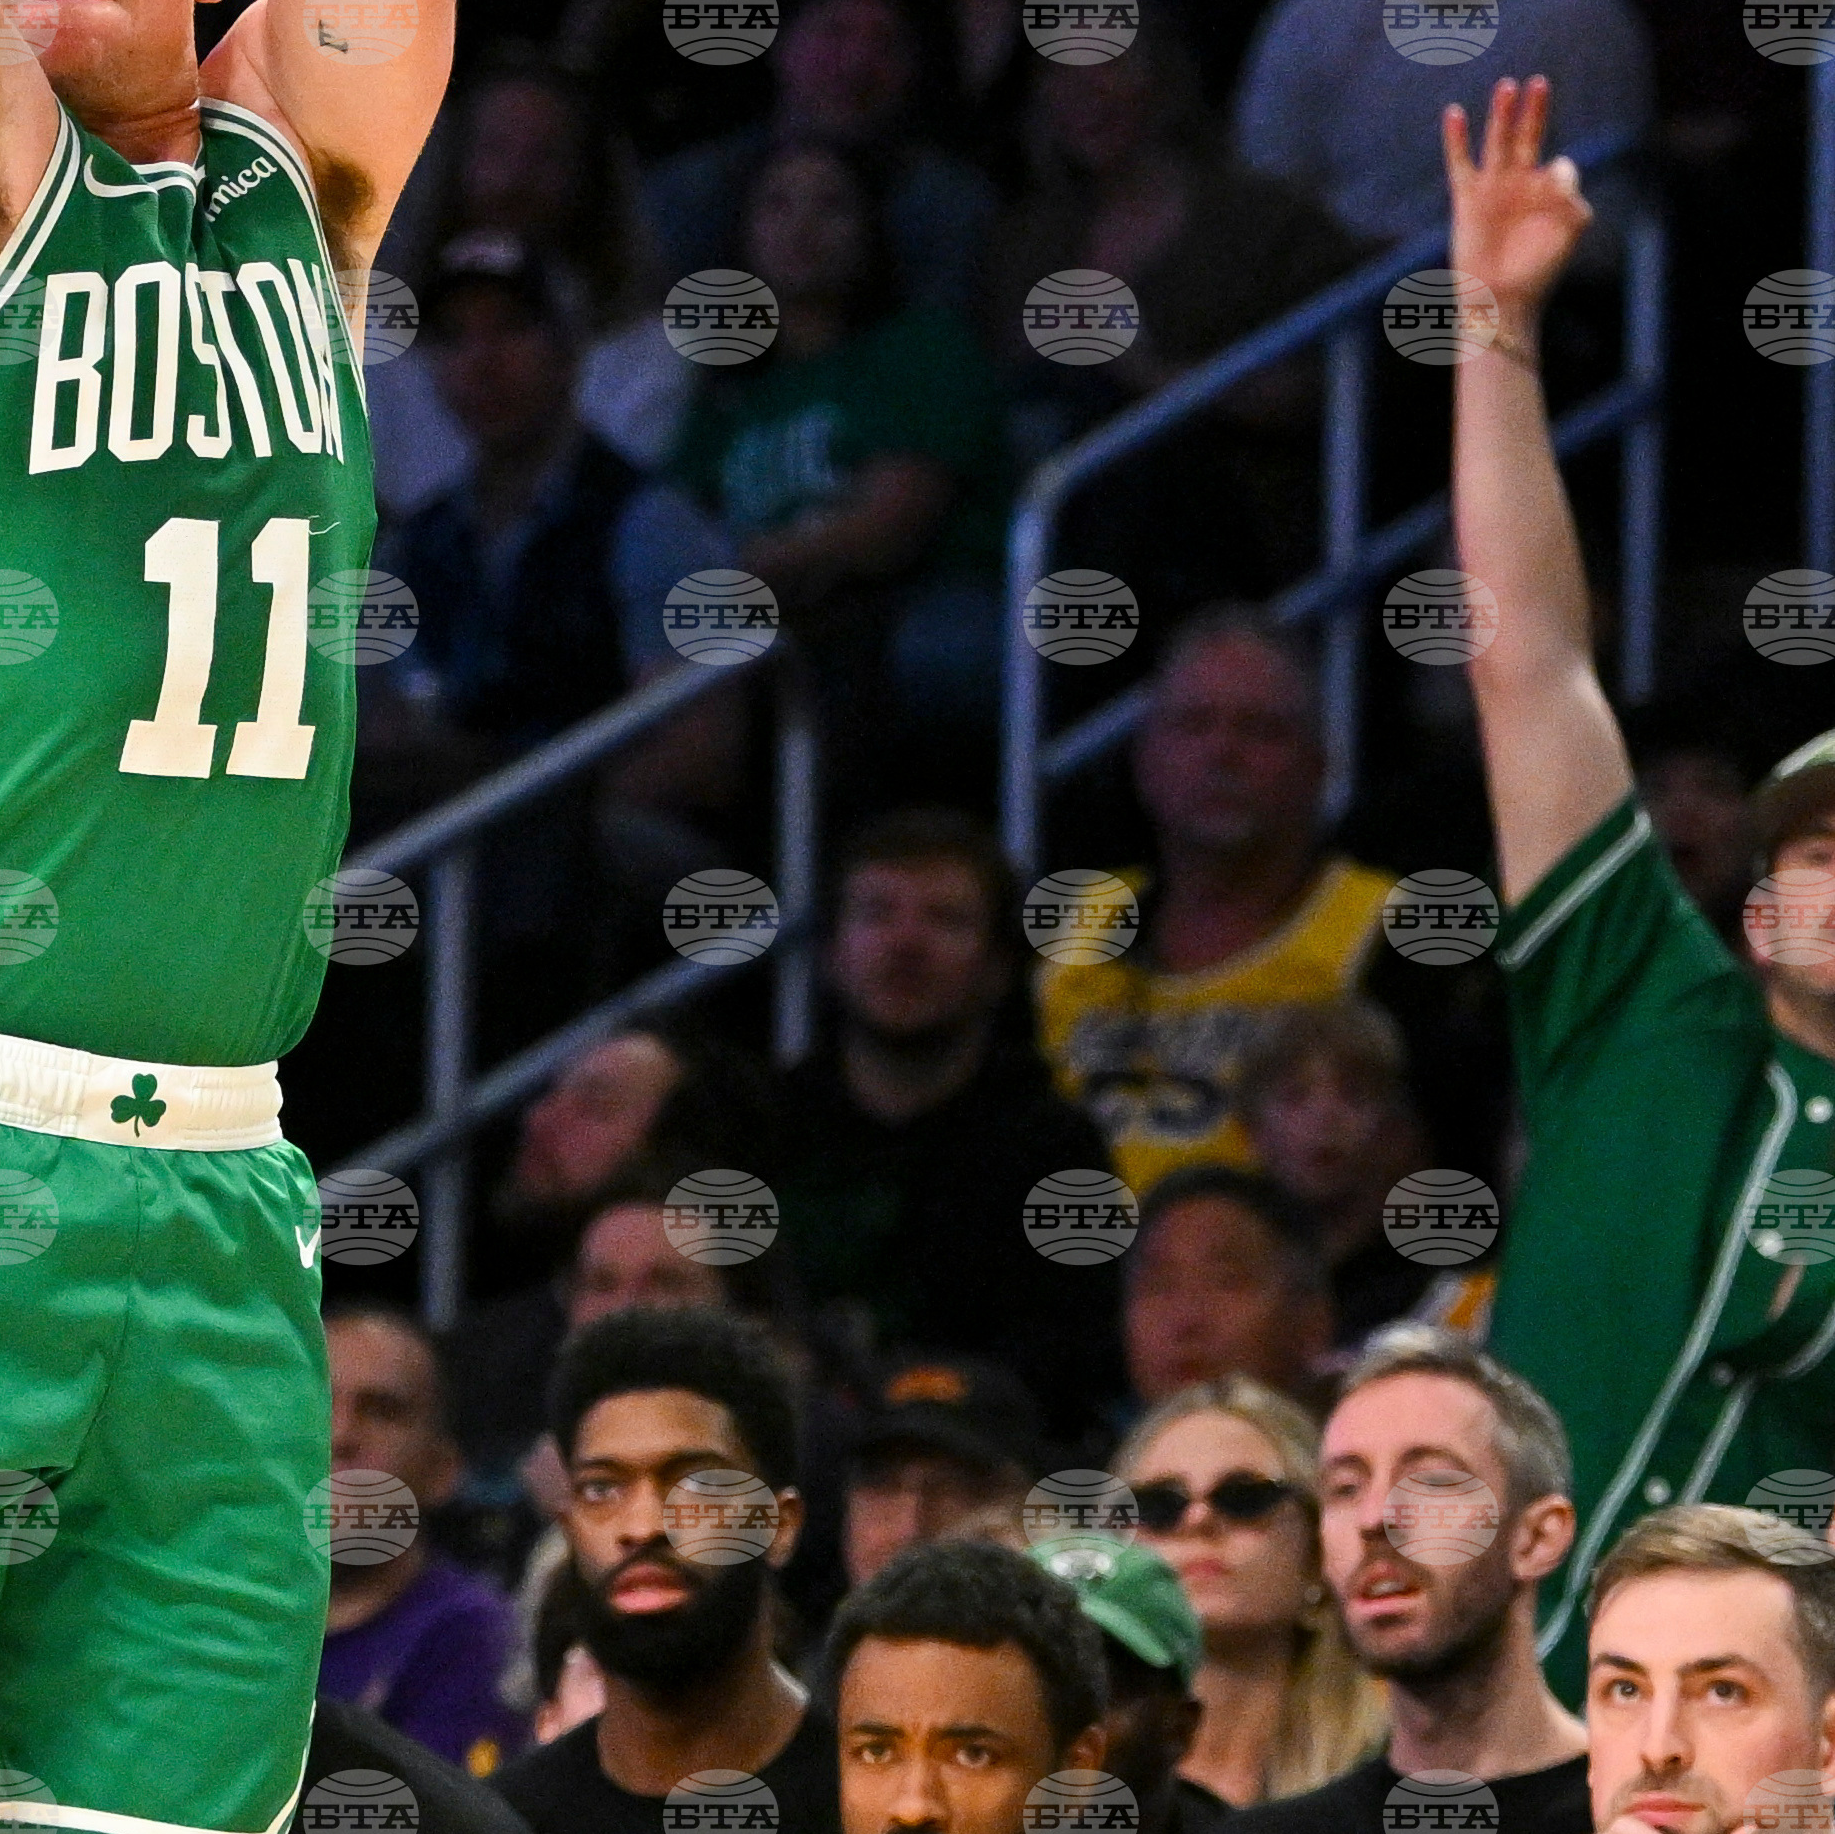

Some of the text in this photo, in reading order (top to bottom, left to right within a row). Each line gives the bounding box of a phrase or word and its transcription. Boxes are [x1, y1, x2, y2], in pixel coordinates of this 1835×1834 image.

[204, 156, 278, 222] mica
[28, 258, 344, 477] BOSTON
[118, 517, 315, 780] 11
